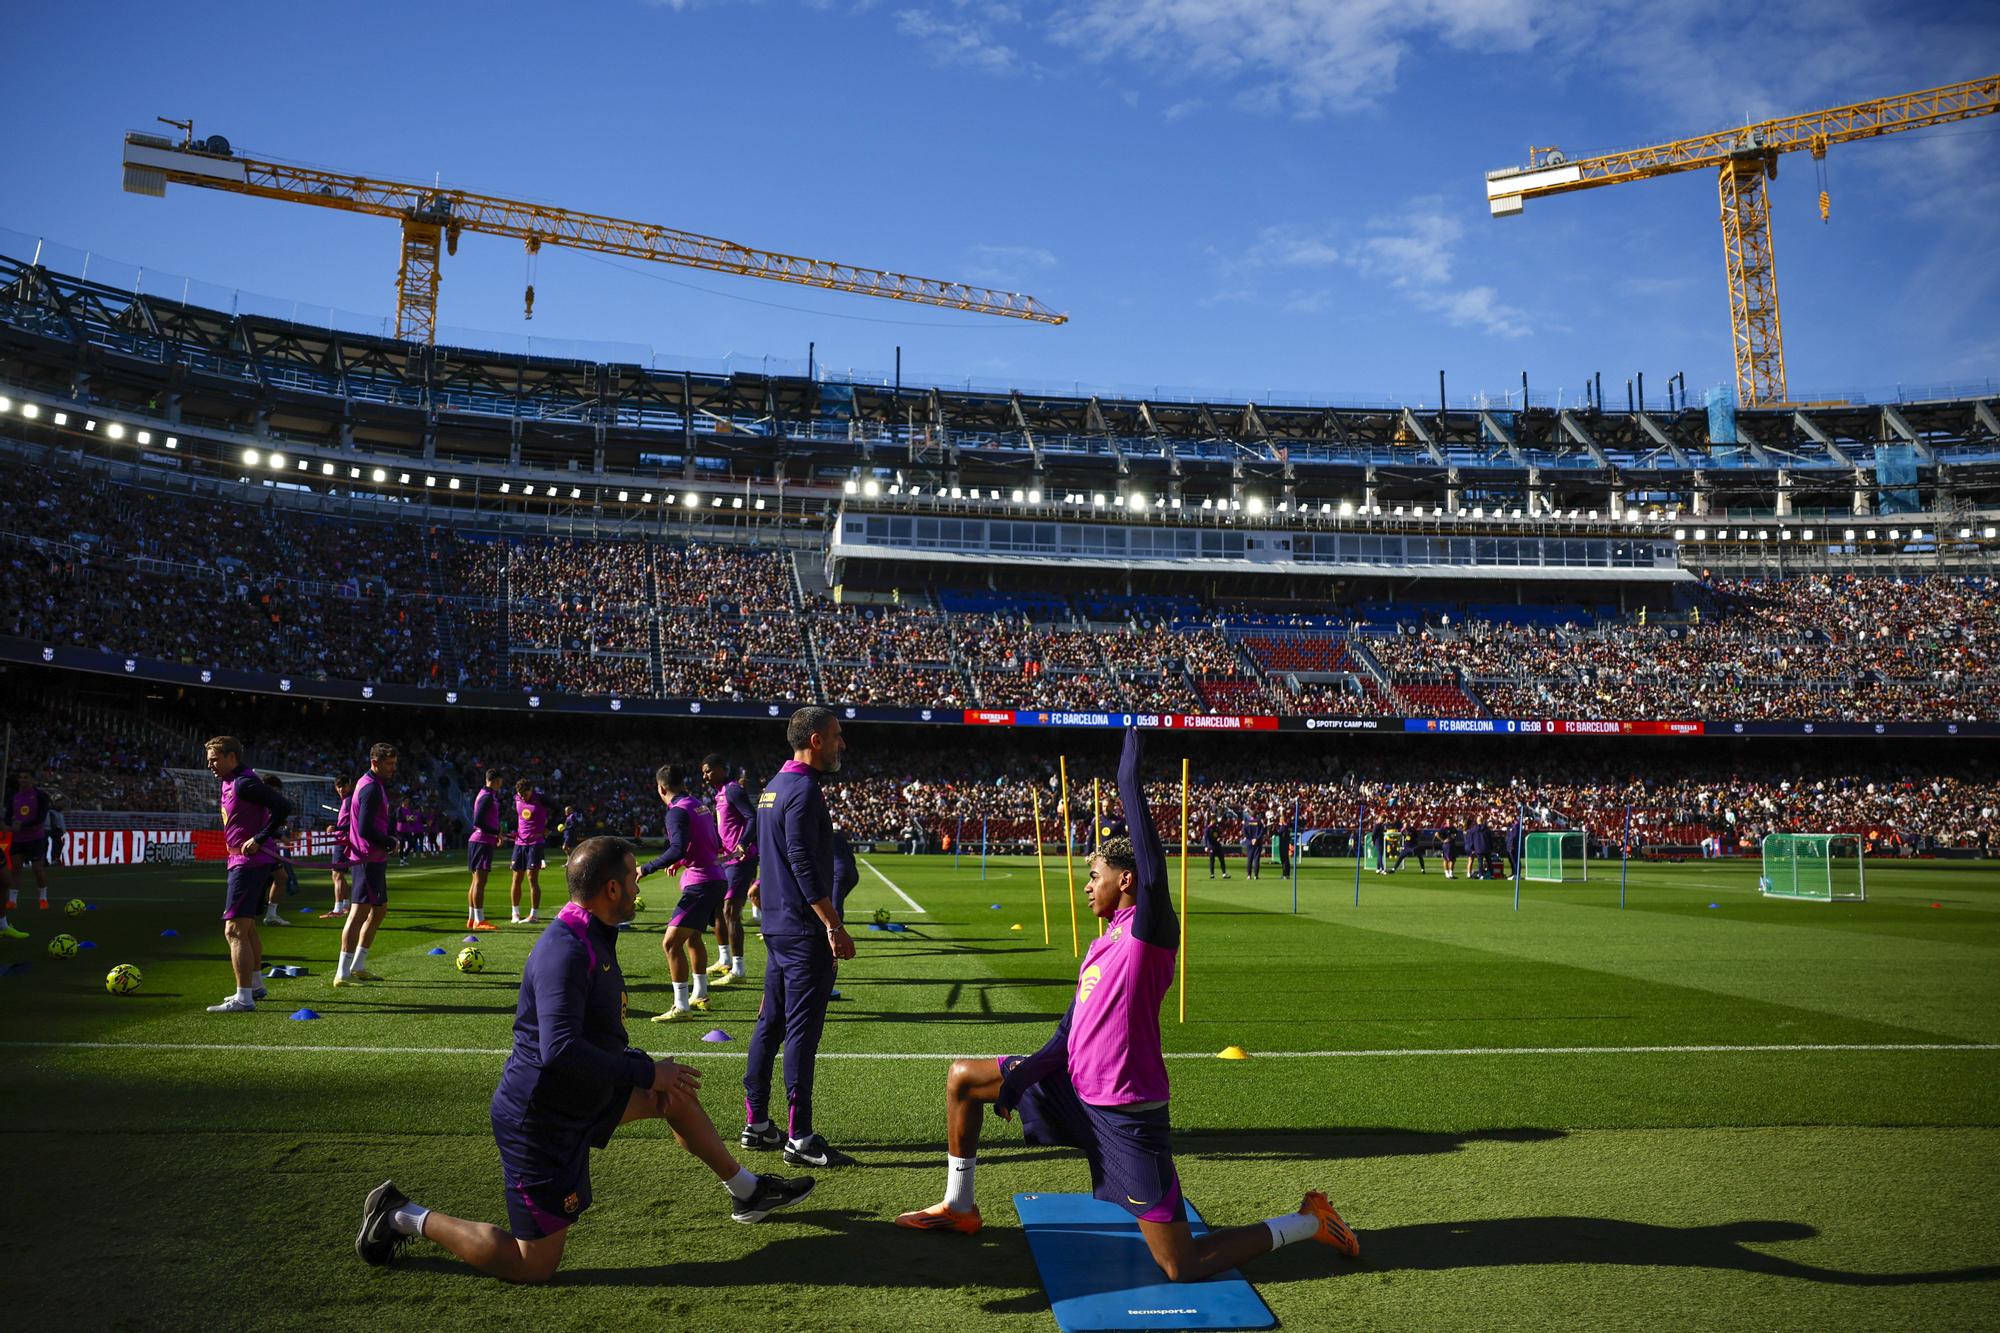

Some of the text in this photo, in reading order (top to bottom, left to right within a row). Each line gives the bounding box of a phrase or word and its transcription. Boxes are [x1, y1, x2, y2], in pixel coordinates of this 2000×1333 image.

[1051, 713, 1108, 725] FC BARCELONA
[1123, 714, 1172, 727] 0 05:08 0
[1184, 716, 1240, 728] FC BARCELONA
[1316, 720, 1342, 728] SPOTIFY
[1343, 720, 1363, 728] CAMP
[1439, 720, 1494, 731] FC BARCELONA
[1507, 721, 1554, 732] 0 05:08 0
[1565, 721, 1620, 733] FC BARCELONA
[46, 830, 125, 866] RELLA
